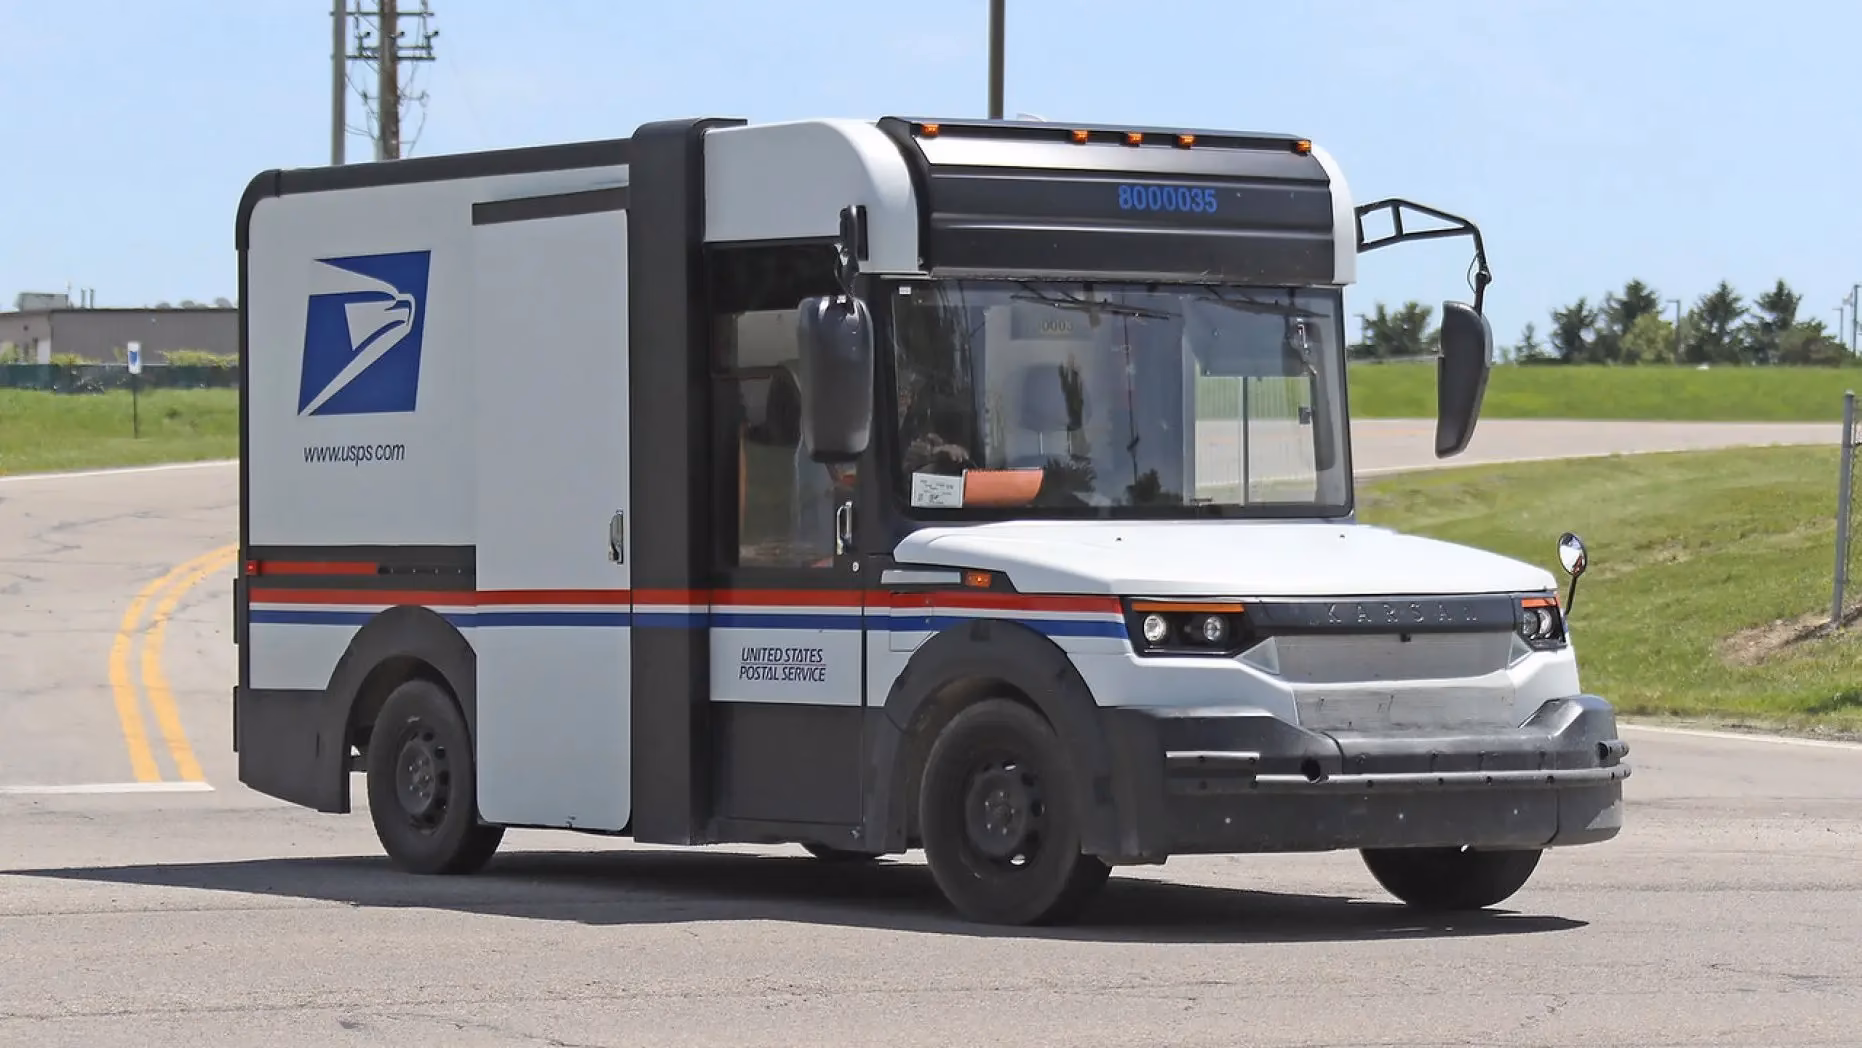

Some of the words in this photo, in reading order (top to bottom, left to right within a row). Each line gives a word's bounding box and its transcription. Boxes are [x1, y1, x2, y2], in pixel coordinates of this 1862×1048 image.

[1118, 184, 1217, 213] 8000035
[303, 443, 405, 467] www.uspscom
[741, 646, 783, 662] UNITED
[784, 647, 823, 663] STATES
[739, 665, 779, 681] POSTAL
[781, 666, 826, 682] SERVICE
